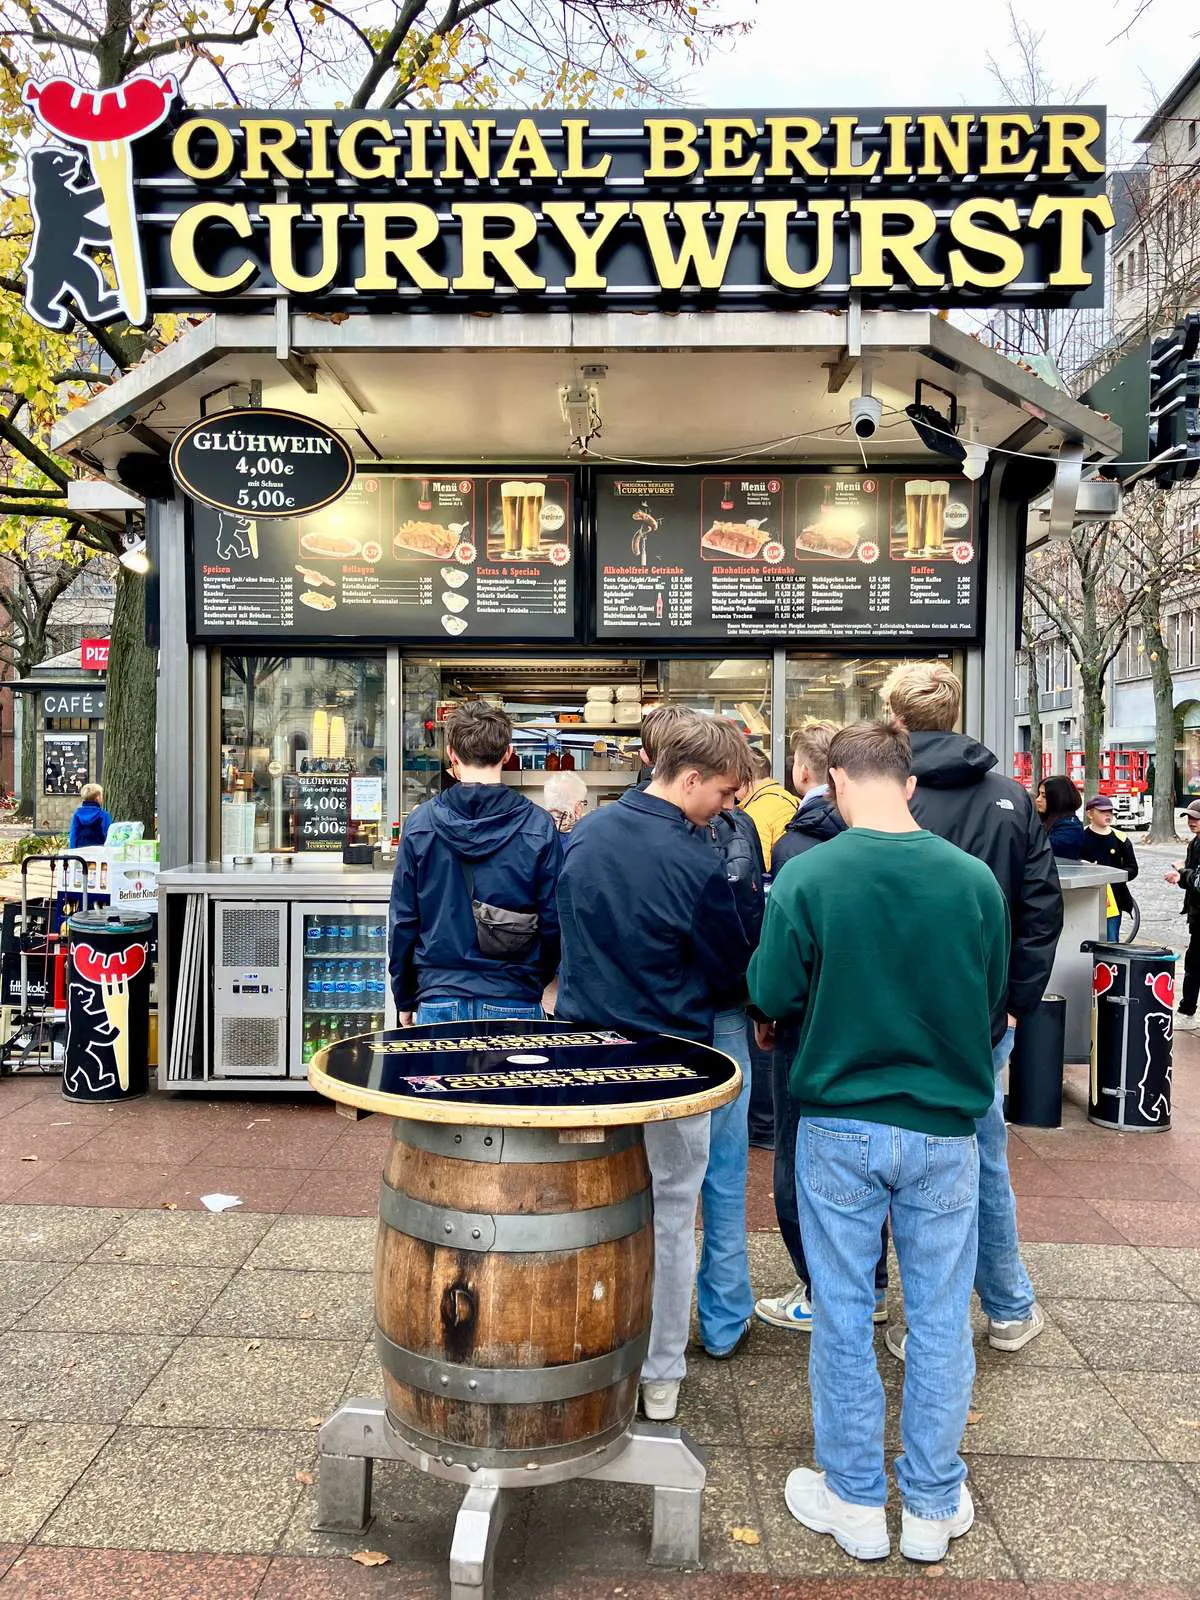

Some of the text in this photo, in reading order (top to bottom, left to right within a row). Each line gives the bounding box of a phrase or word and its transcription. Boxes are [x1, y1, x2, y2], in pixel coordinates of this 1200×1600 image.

[171, 113, 1106, 181] ORIGINAL BERLINER
[169, 194, 1116, 293] CURRYWURST
[193, 430, 332, 454] GLÜHWEIN
[235, 456, 294, 476] 4,00€
[433, 482, 457, 492] Menü
[741, 482, 766, 492] Menü
[836, 482, 860, 492] Menü
[236, 489, 295, 509] 5,00€
[203, 565, 231, 574] Speisen
[510, 568, 540, 577] Specials
[712, 566, 760, 574] Alkoholische
[911, 566, 936, 575] Kaffee
[44, 693, 94, 713] CAFÉ
[304, 797, 346, 812] 4,00€
[304, 822, 346, 836] 5,00€
[119, 890, 142, 899] Berliner
[444, 1071, 564, 1082] ORIGINAL
[572, 1066, 690, 1077] BERLINER
[450, 1070, 698, 1088] CURRYWURST
